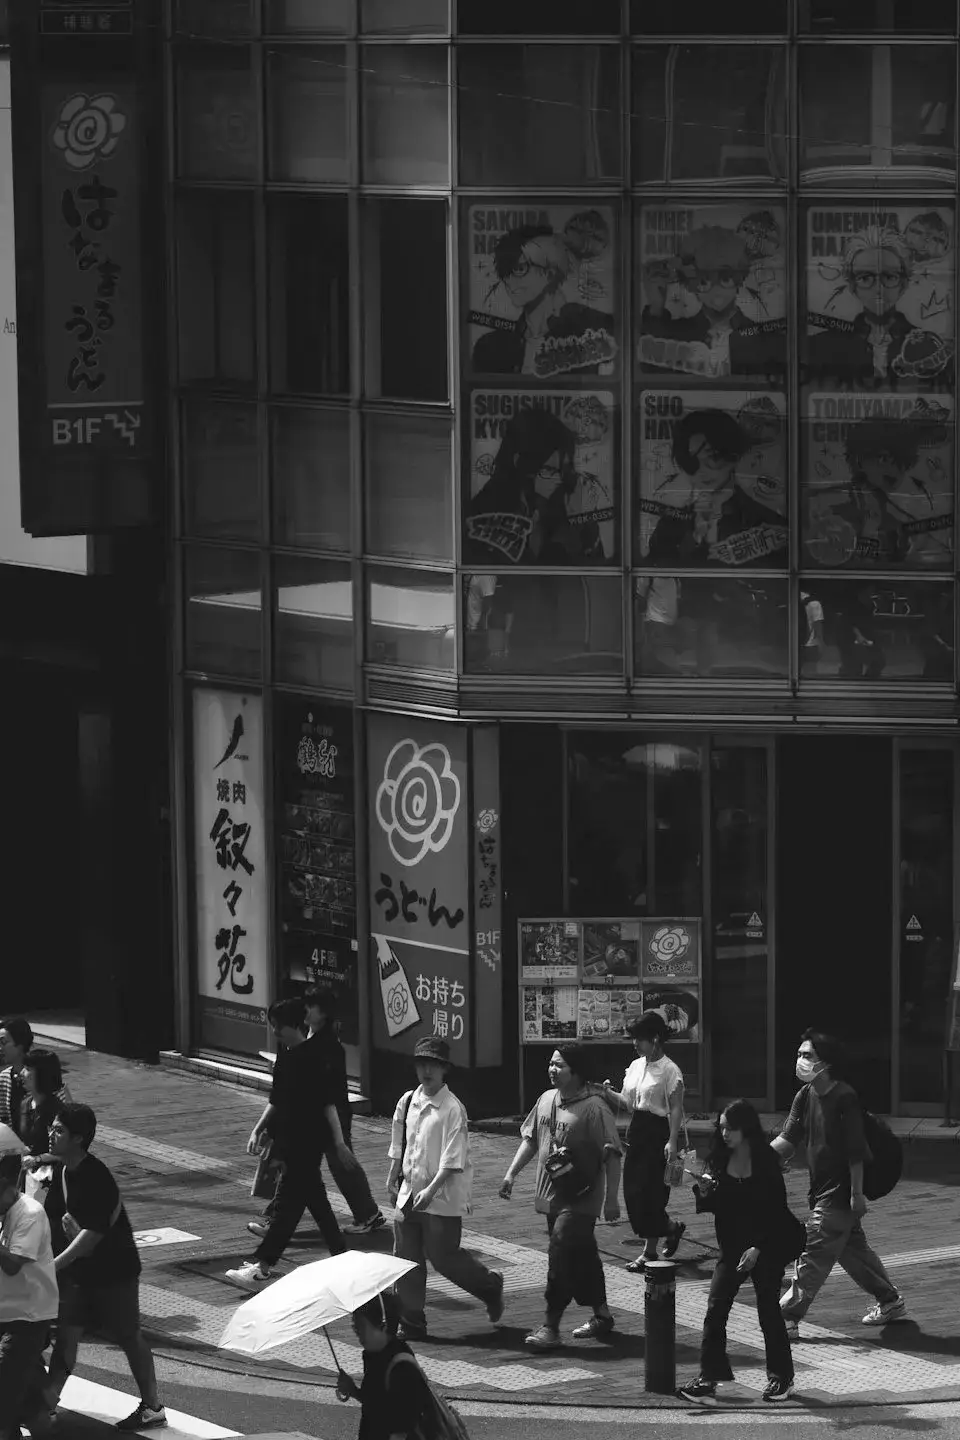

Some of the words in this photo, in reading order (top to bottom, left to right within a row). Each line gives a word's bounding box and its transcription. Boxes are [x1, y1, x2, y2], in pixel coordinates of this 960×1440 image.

[645, 396, 683, 417] SUO
[52, 418, 101, 445] B1F
[216, 778, 247, 805] 焼肉
[210, 808, 255, 995] 叙々苑
[375, 873, 465, 929] うどん
[477, 932, 501, 946] B1F
[415, 973, 466, 1007] お持ち
[432, 1009, 465, 1040] 帰り
